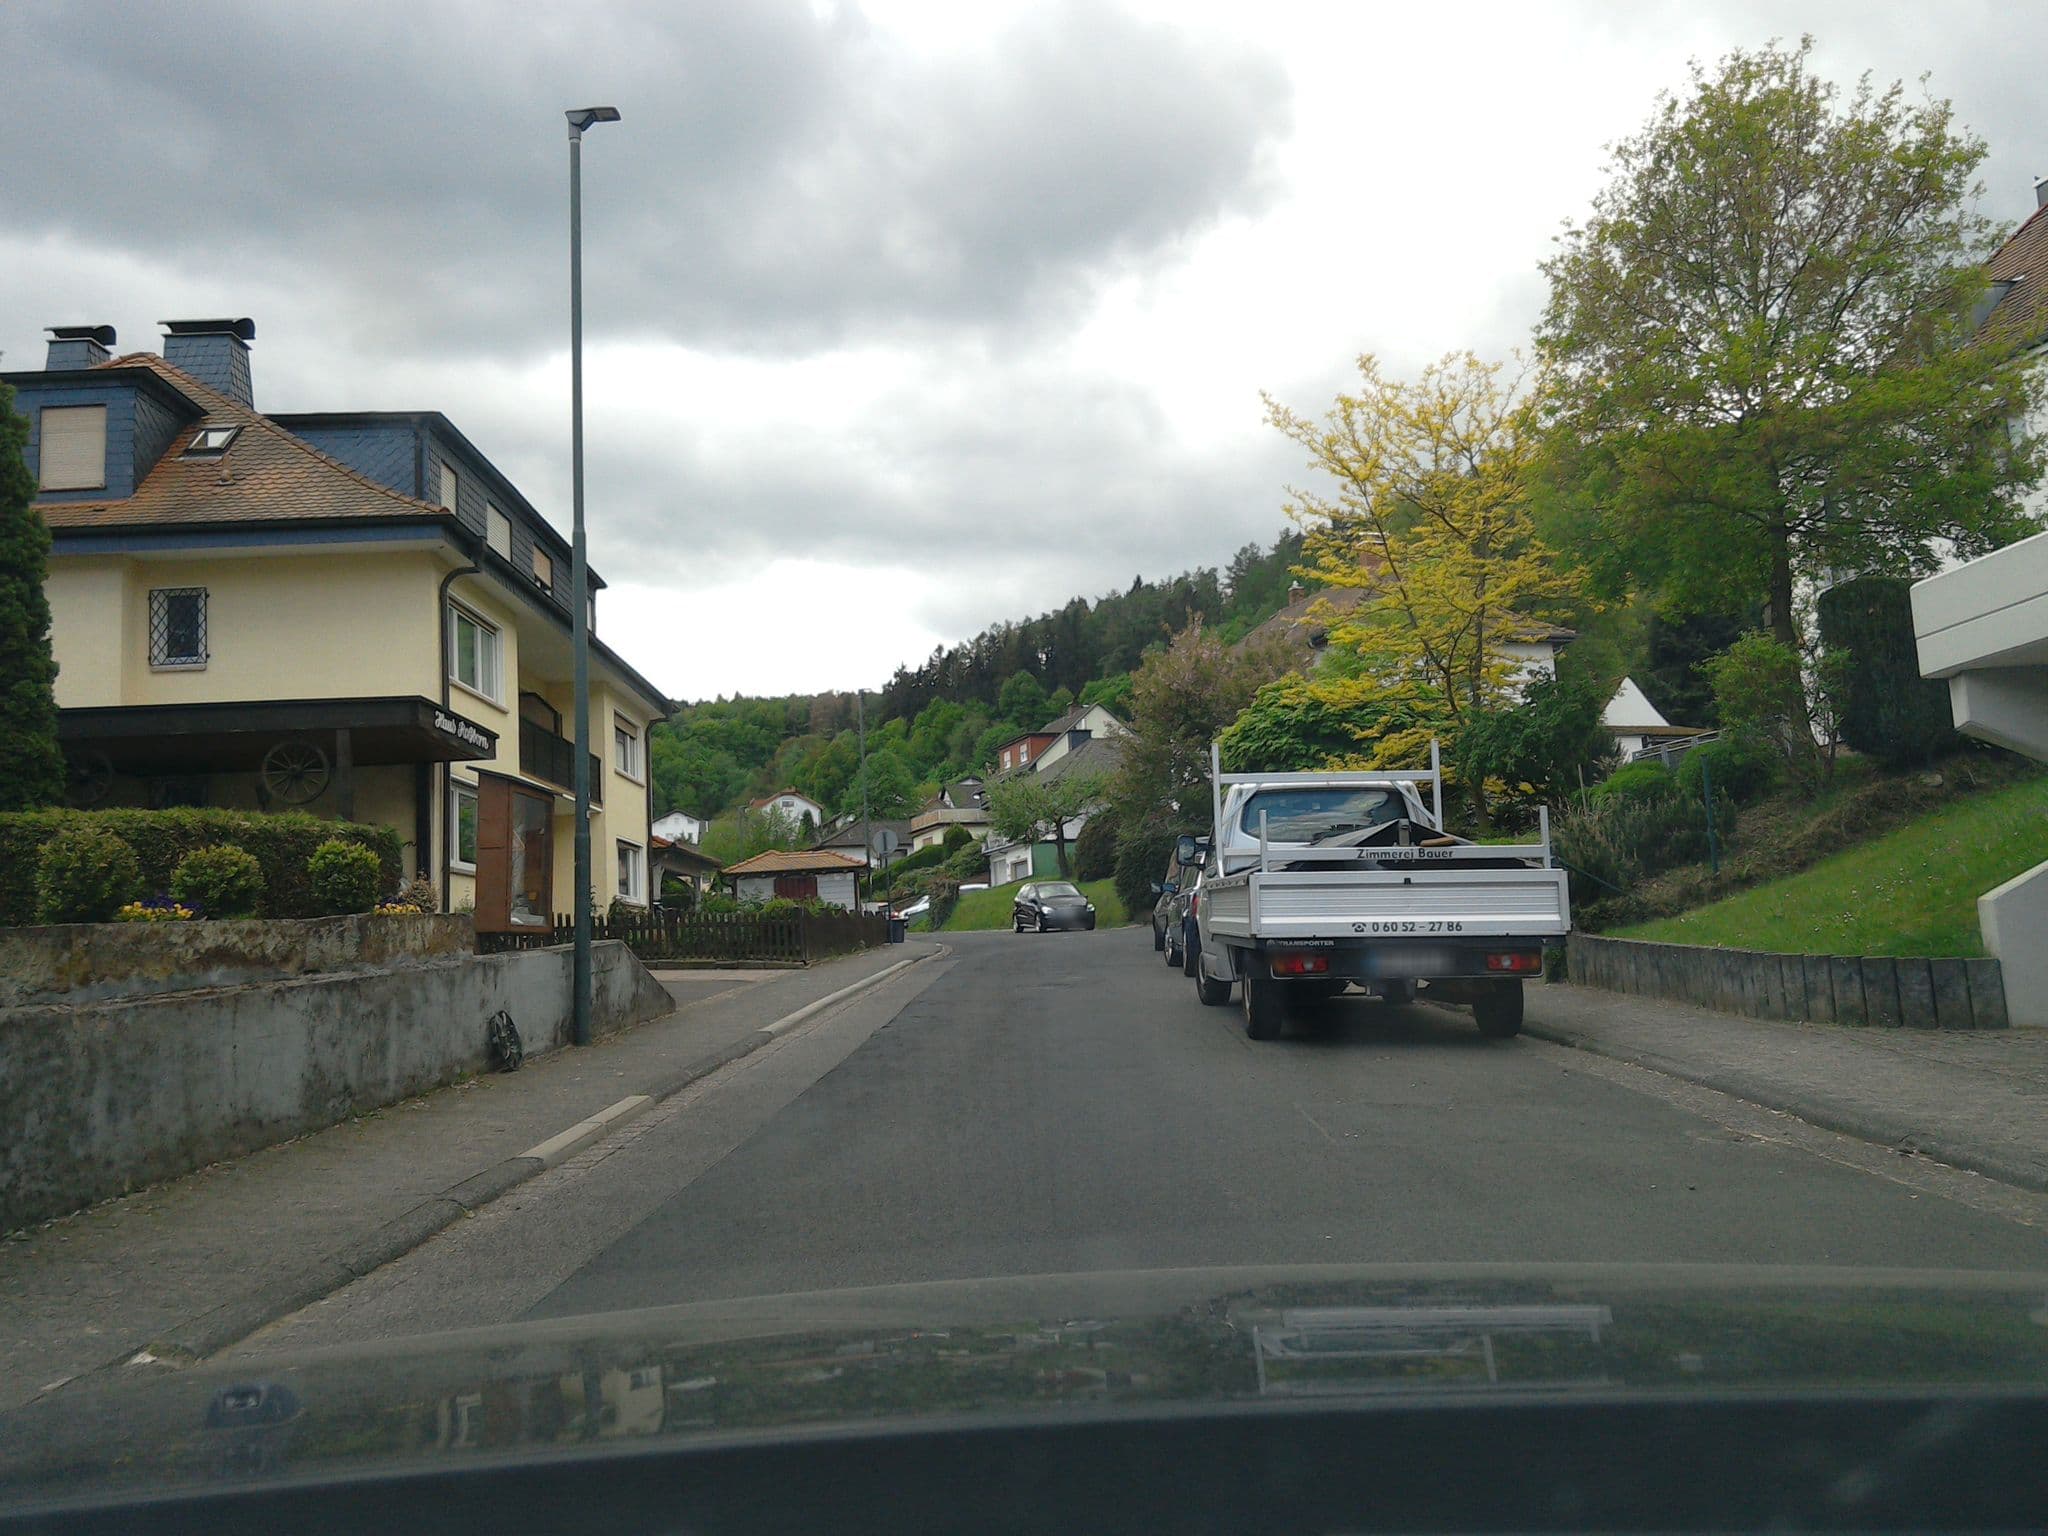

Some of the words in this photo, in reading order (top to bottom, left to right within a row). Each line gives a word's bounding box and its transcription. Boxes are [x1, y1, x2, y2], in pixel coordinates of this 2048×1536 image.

[435, 710, 457, 735] Haus
[1357, 848, 1414, 859] Zimmerei
[1418, 847, 1454, 859] Bauer
[1371, 921, 1380, 932] 0
[1382, 921, 1399, 932] 60
[1401, 921, 1417, 932] 52
[1428, 921, 1443, 932] 27
[1446, 921, 1463, 932] 86
